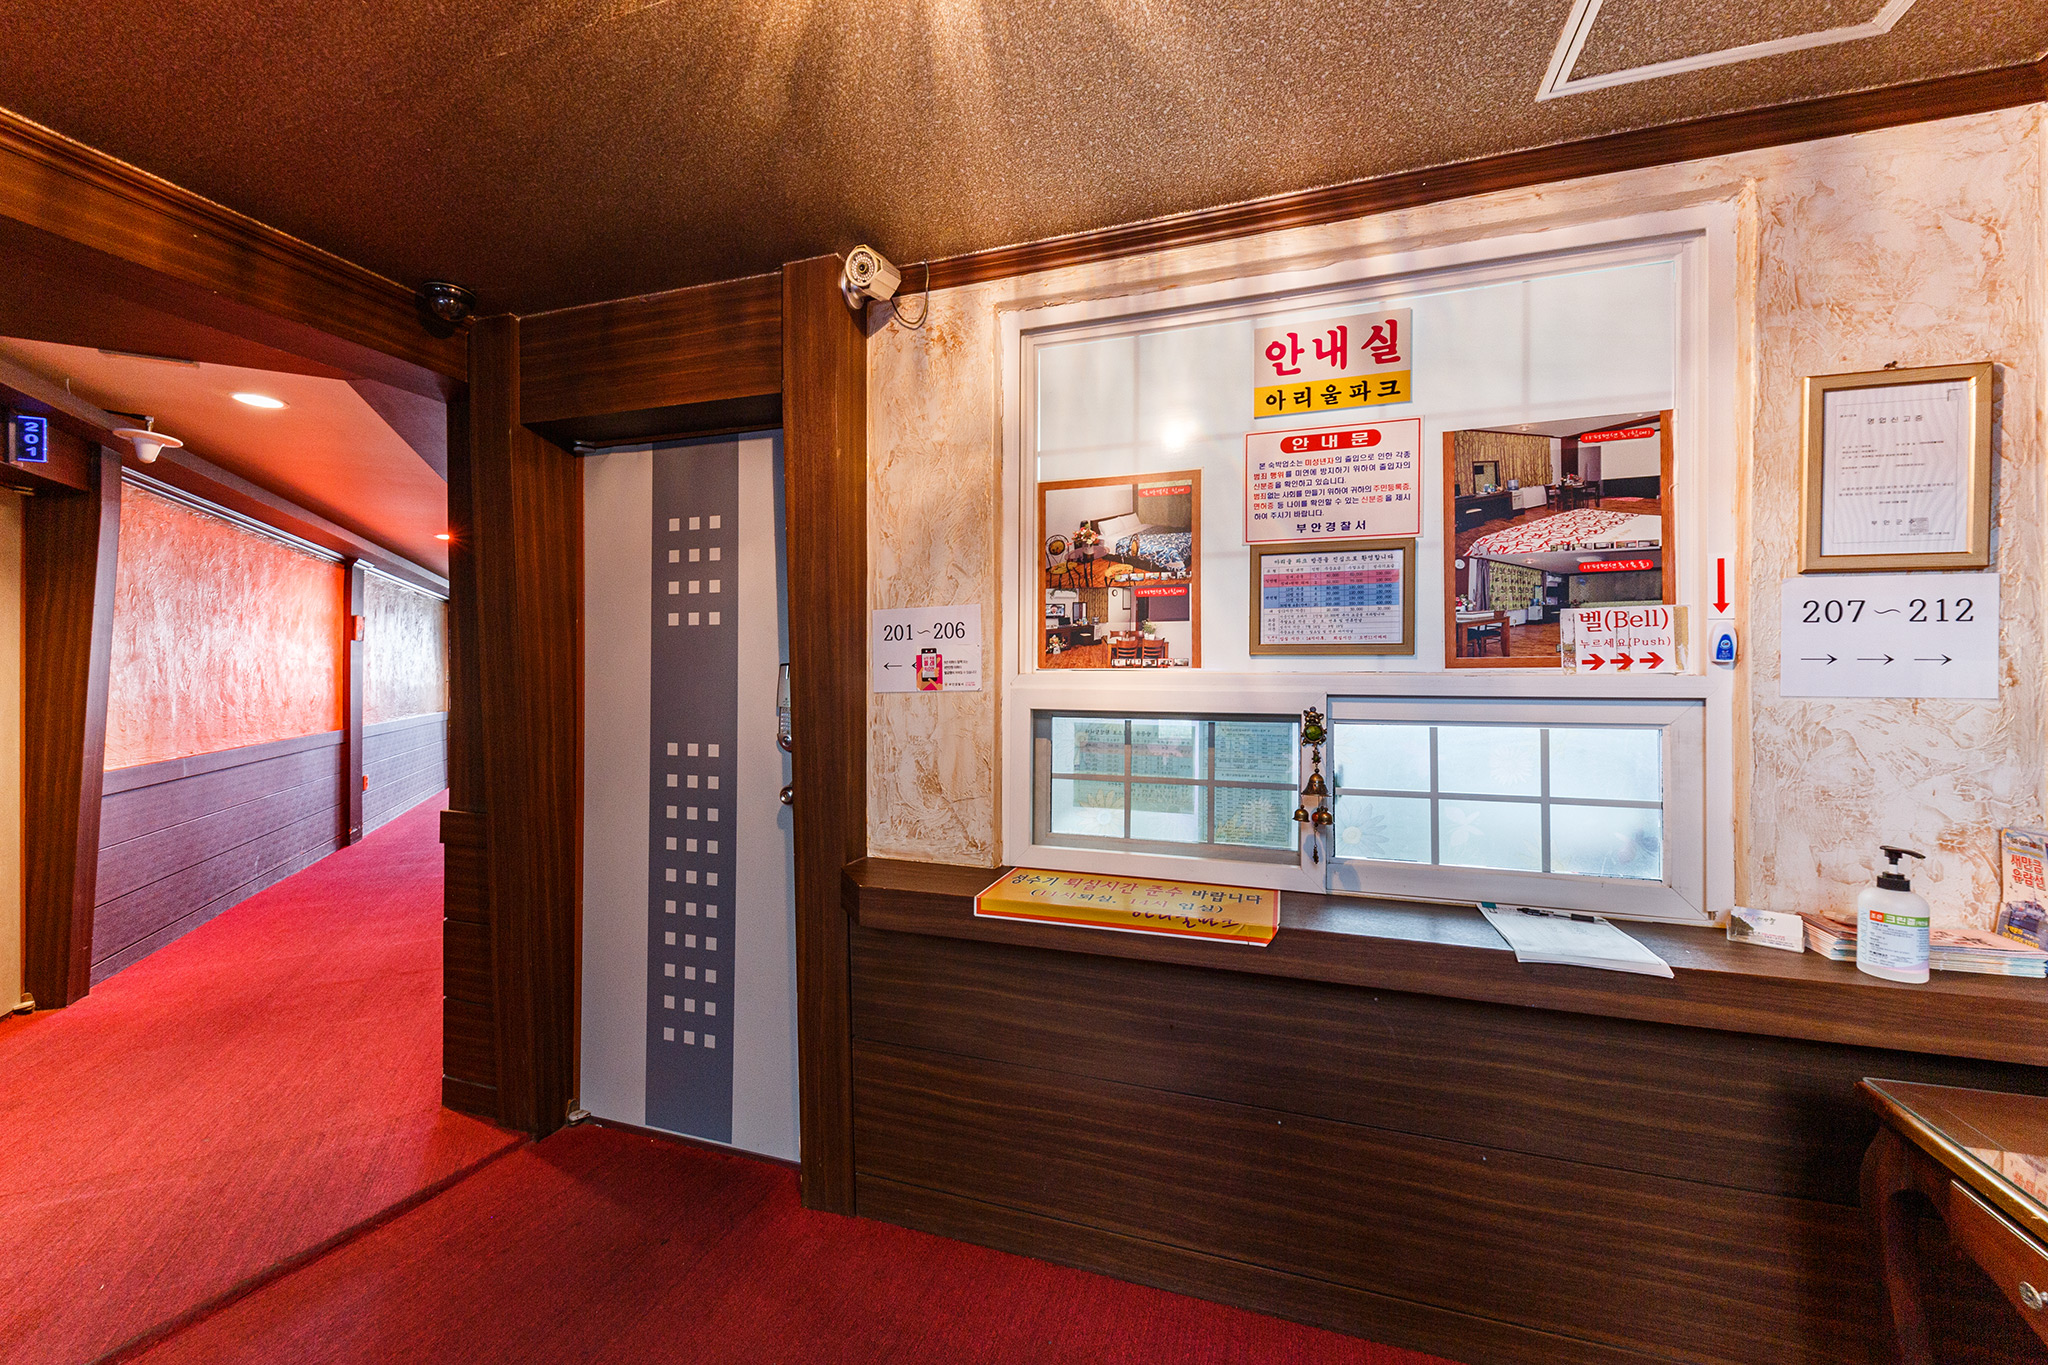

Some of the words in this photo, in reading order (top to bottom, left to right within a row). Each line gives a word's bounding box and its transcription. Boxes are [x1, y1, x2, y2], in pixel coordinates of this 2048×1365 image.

[1265, 319, 1401, 376] 안내실
[1265, 380, 1401, 411] 아리울파크
[24, 421, 39, 457] 201
[1268, 459, 1303, 469] 숙박업소는
[1345, 453, 1374, 463] 출입으로
[1377, 452, 1393, 460] 인한
[1395, 450, 1411, 459] 각종
[1295, 468, 1317, 477] 미연에
[1320, 466, 1350, 475] 방지하기
[1353, 463, 1376, 473] 위하여
[1380, 461, 1411, 471] 출입자의
[1282, 490, 1302, 498] 사회를
[1304, 488, 1325, 497] 만들기
[1327, 487, 1348, 495] 위하여
[1284, 479, 1312, 488] 확인하고
[1286, 500, 1307, 508] 나이를
[1310, 498, 1332, 507] 확인할
[1344, 497, 1359, 505] 있는
[1395, 493, 1411, 502] 제시
[1254, 512, 1268, 520] 하여
[1270, 511, 1291, 519] 주시기
[1296, 520, 1367, 533] 부안경찰서
[1578, 607, 1669, 633] 벨(Bell)
[1579, 636, 1671, 649] 누르세요(Push)
[2011, 854, 2043, 875] 새만금
[2012, 868, 2046, 891] 유람선
[1011, 874, 1060, 886] 성수기
[1063, 878, 1139, 895] 퇴실시간
[1145, 884, 1183, 897] 준수
[1191, 889, 1263, 905] 바랍니다
